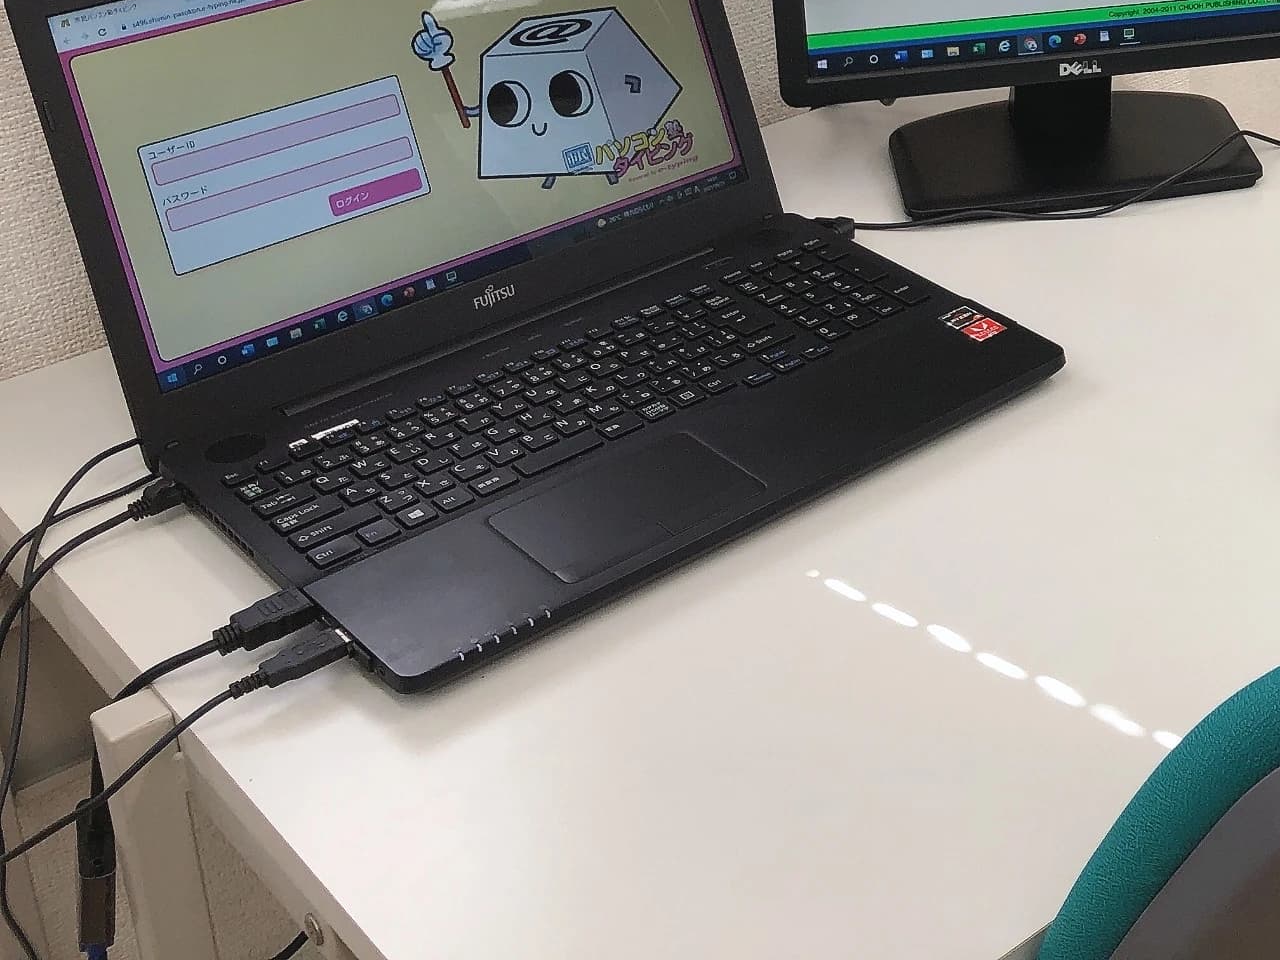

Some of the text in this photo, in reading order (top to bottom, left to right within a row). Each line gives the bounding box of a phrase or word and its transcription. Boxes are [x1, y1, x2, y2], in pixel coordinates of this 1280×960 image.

[1060, 61, 1102, 76] DELL
[336, 190, 369, 209] ログイン
[473, 284, 515, 309] FUJITSU
